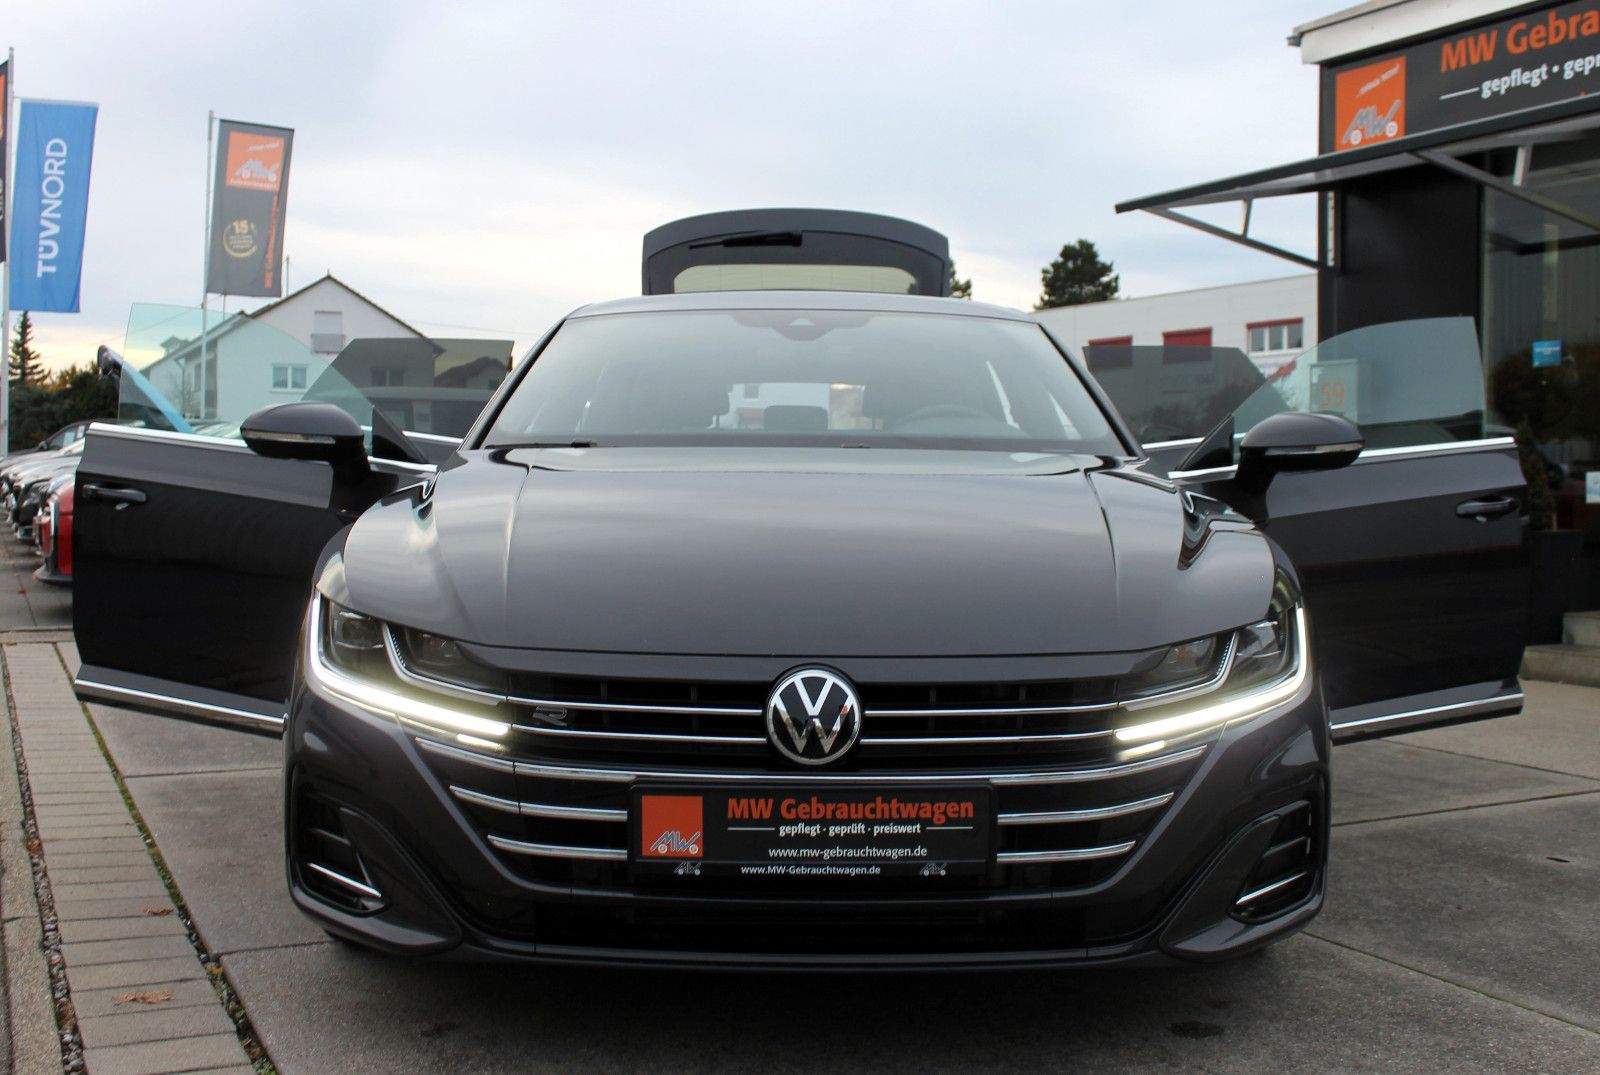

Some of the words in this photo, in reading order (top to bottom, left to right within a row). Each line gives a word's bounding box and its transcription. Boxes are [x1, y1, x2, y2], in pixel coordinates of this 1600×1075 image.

[1440, 29, 1498, 73] MW
[1506, 9, 1600, 55] Gebra
[1481, 63, 1548, 99] gepflegt
[727, 798, 774, 819] MW
[780, 796, 974, 825] Gebrauchtwagen
[779, 822, 821, 837] gepflegt
[828, 822, 866, 837] geprüft
[873, 822, 921, 837] preiswert
[768, 845, 928, 860] www.mw-gebrauchtwagen.de
[740, 865, 881, 877] www.MW-Gebrauchtwagen.de
